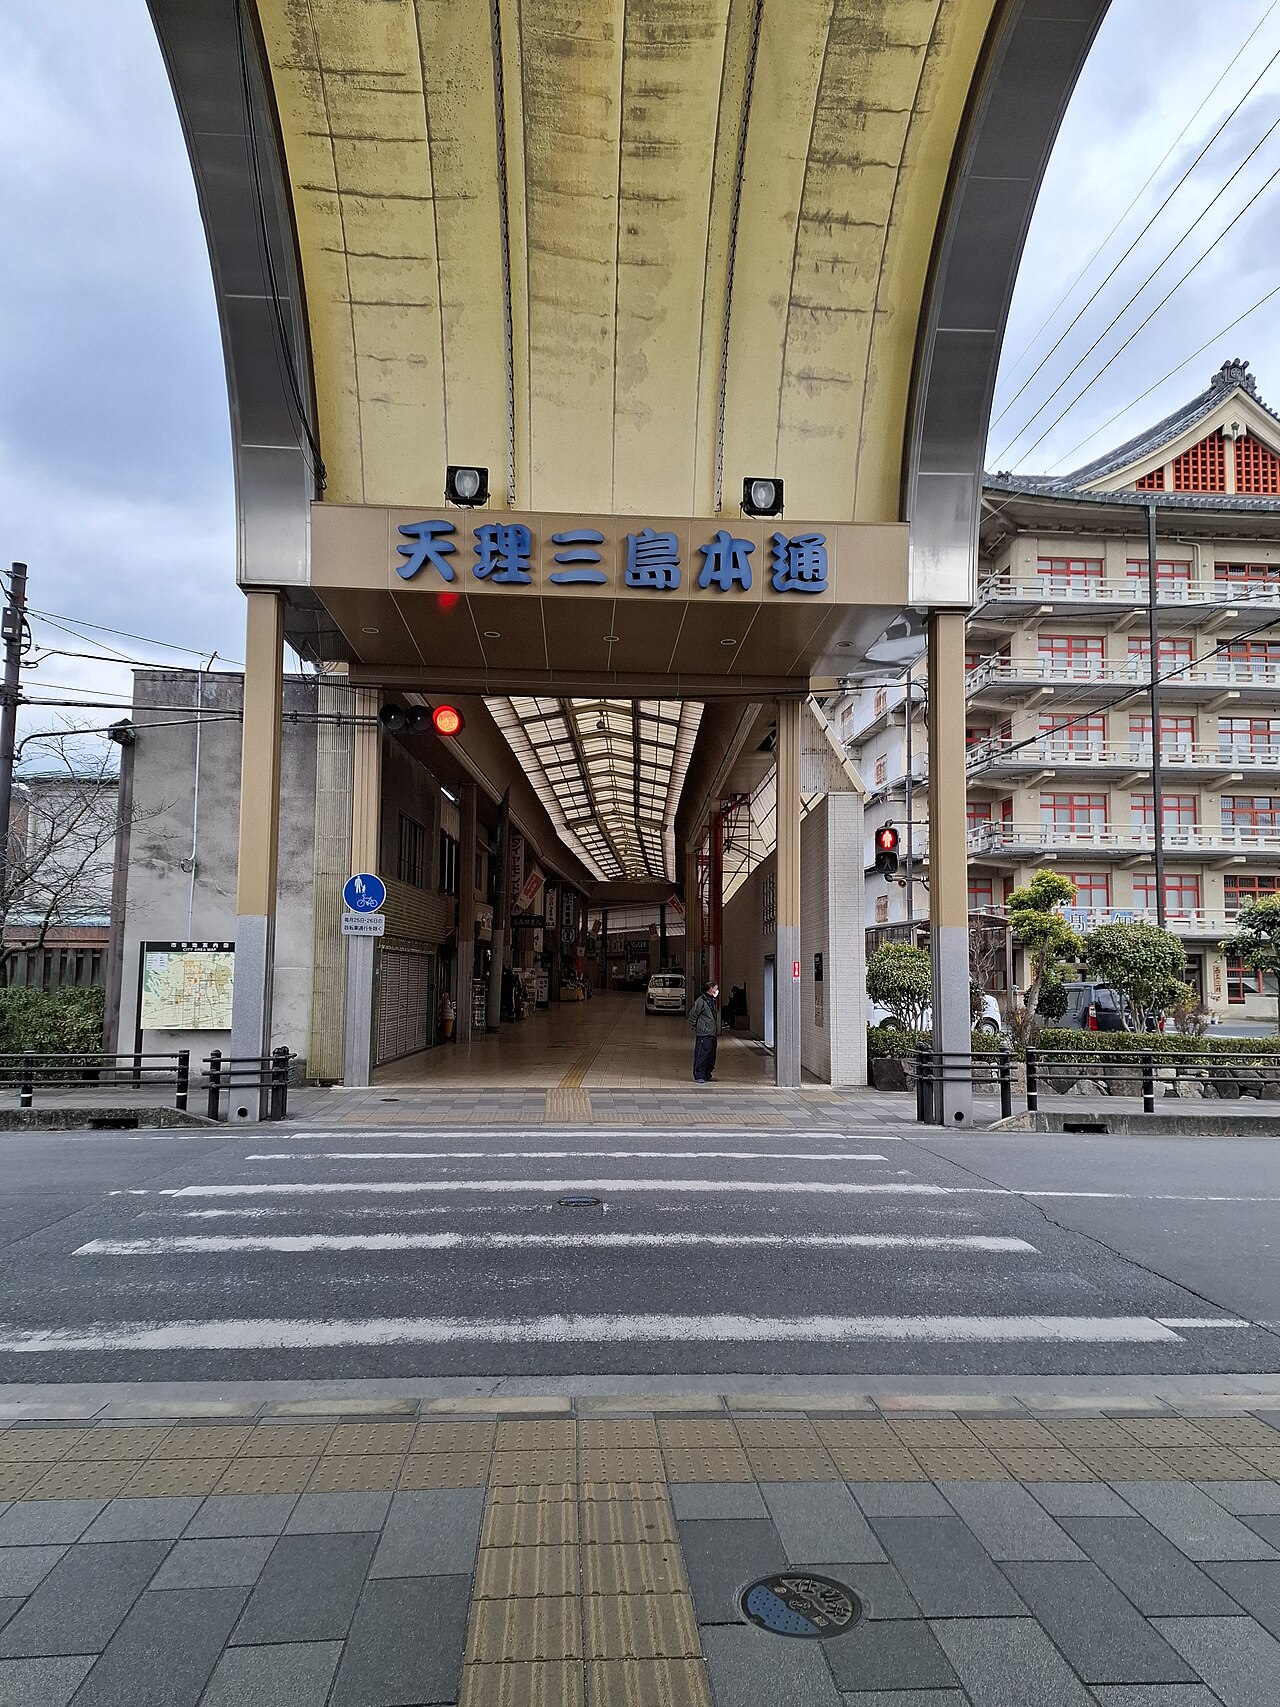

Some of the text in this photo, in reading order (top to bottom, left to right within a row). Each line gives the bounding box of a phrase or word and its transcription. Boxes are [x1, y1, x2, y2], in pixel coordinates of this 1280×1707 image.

[396, 520, 829, 592] 天理三島本通
